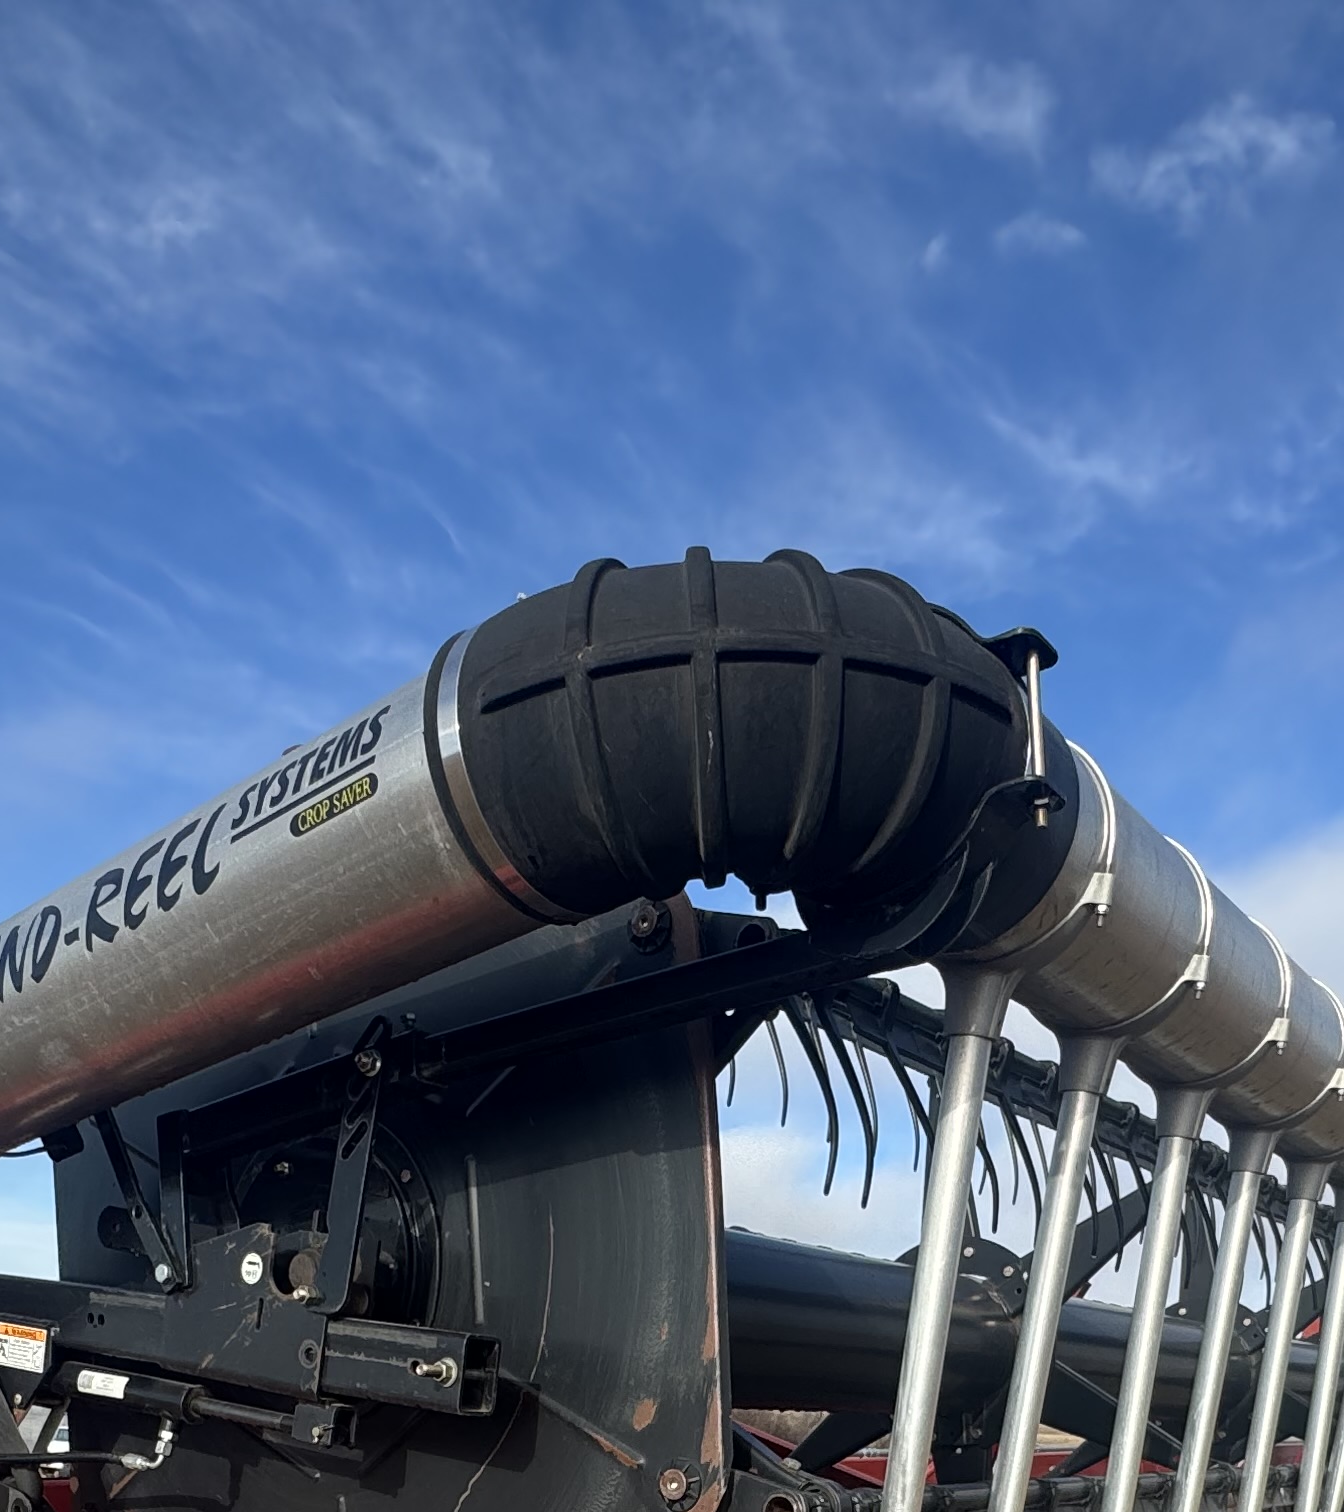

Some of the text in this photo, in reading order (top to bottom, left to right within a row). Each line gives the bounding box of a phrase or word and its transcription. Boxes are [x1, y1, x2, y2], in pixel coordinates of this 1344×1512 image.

[230, 704, 392, 830] SYSTEMS
[297, 776, 373, 832] CROP SAVER
